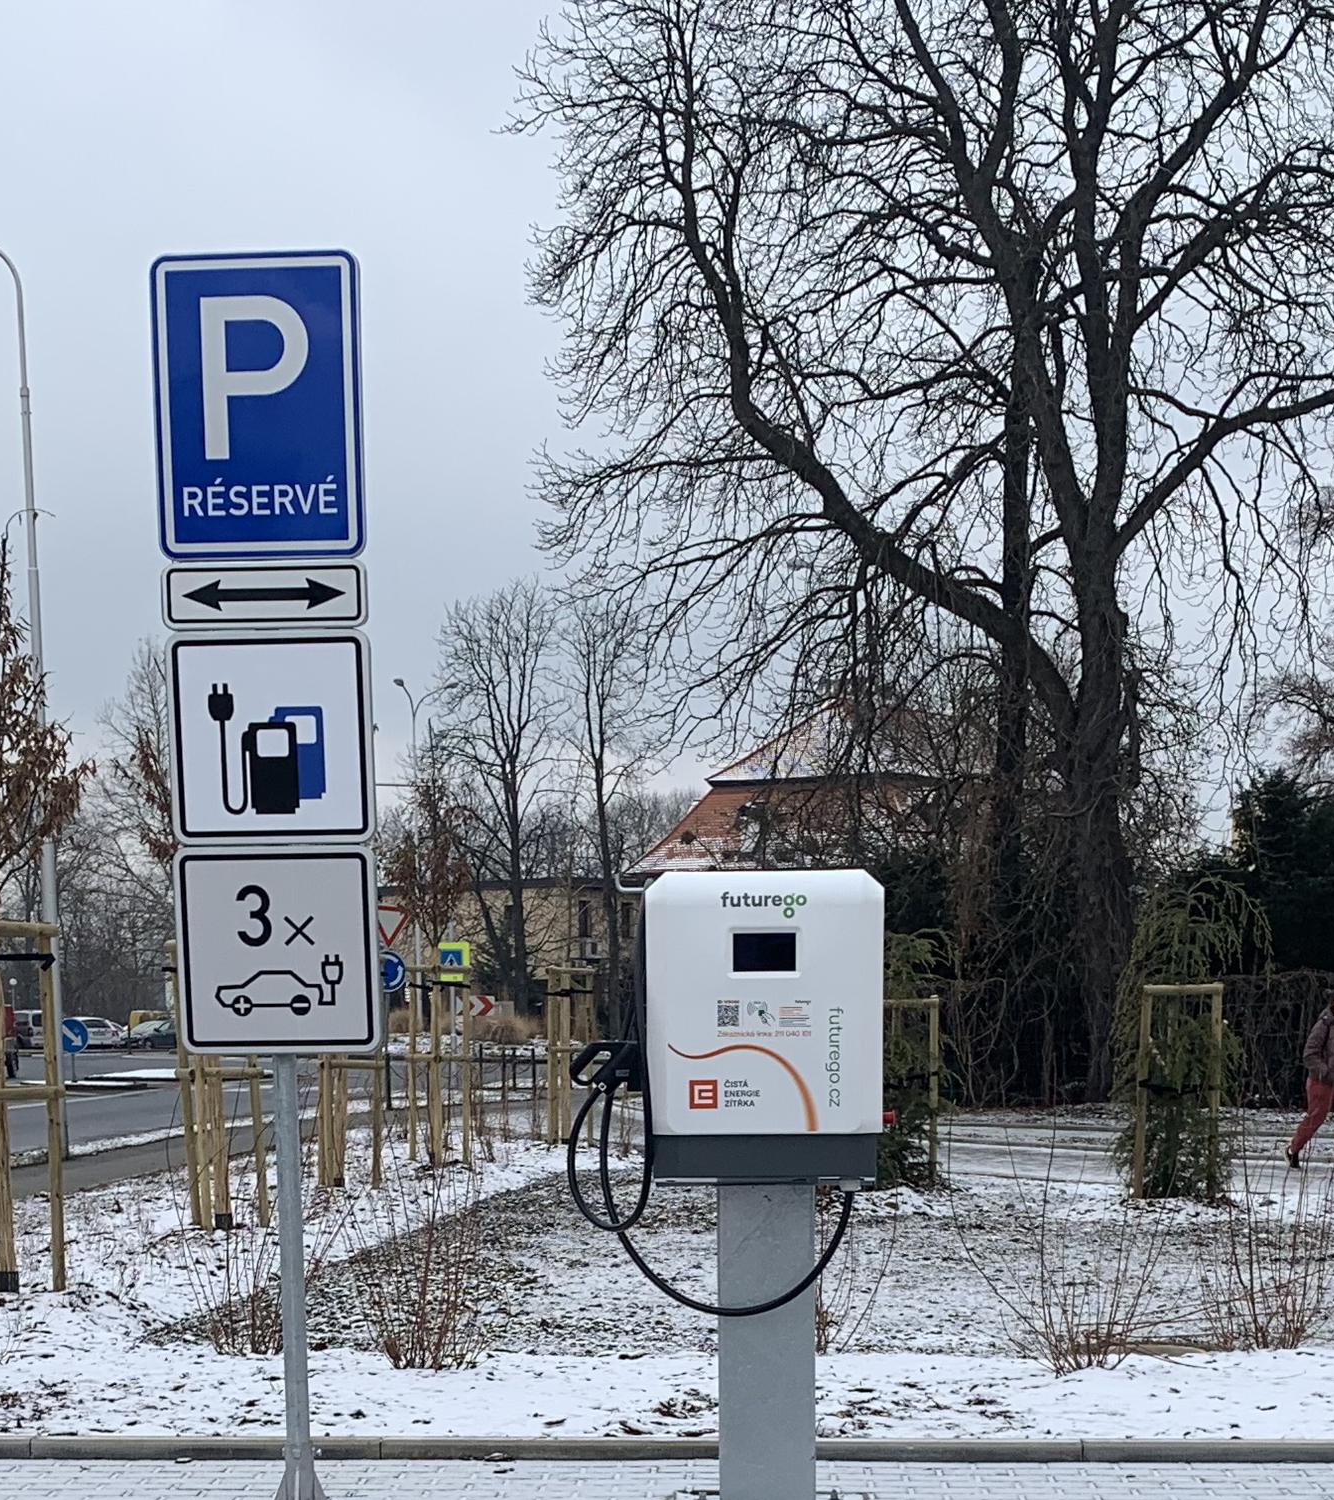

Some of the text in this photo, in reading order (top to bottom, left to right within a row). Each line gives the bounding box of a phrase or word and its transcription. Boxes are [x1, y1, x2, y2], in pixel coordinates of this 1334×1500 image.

[199, 295, 308, 460] P
[182, 475, 338, 517] RÉSERVÉ
[720, 891, 807, 918] futurego
[825, 1006, 844, 1108] futurego.cz
[724, 1079, 748, 1088] ČISTÁ
[724, 1090, 760, 1098] ENERGIE
[724, 1098, 755, 1107] ZÍTŘKA
